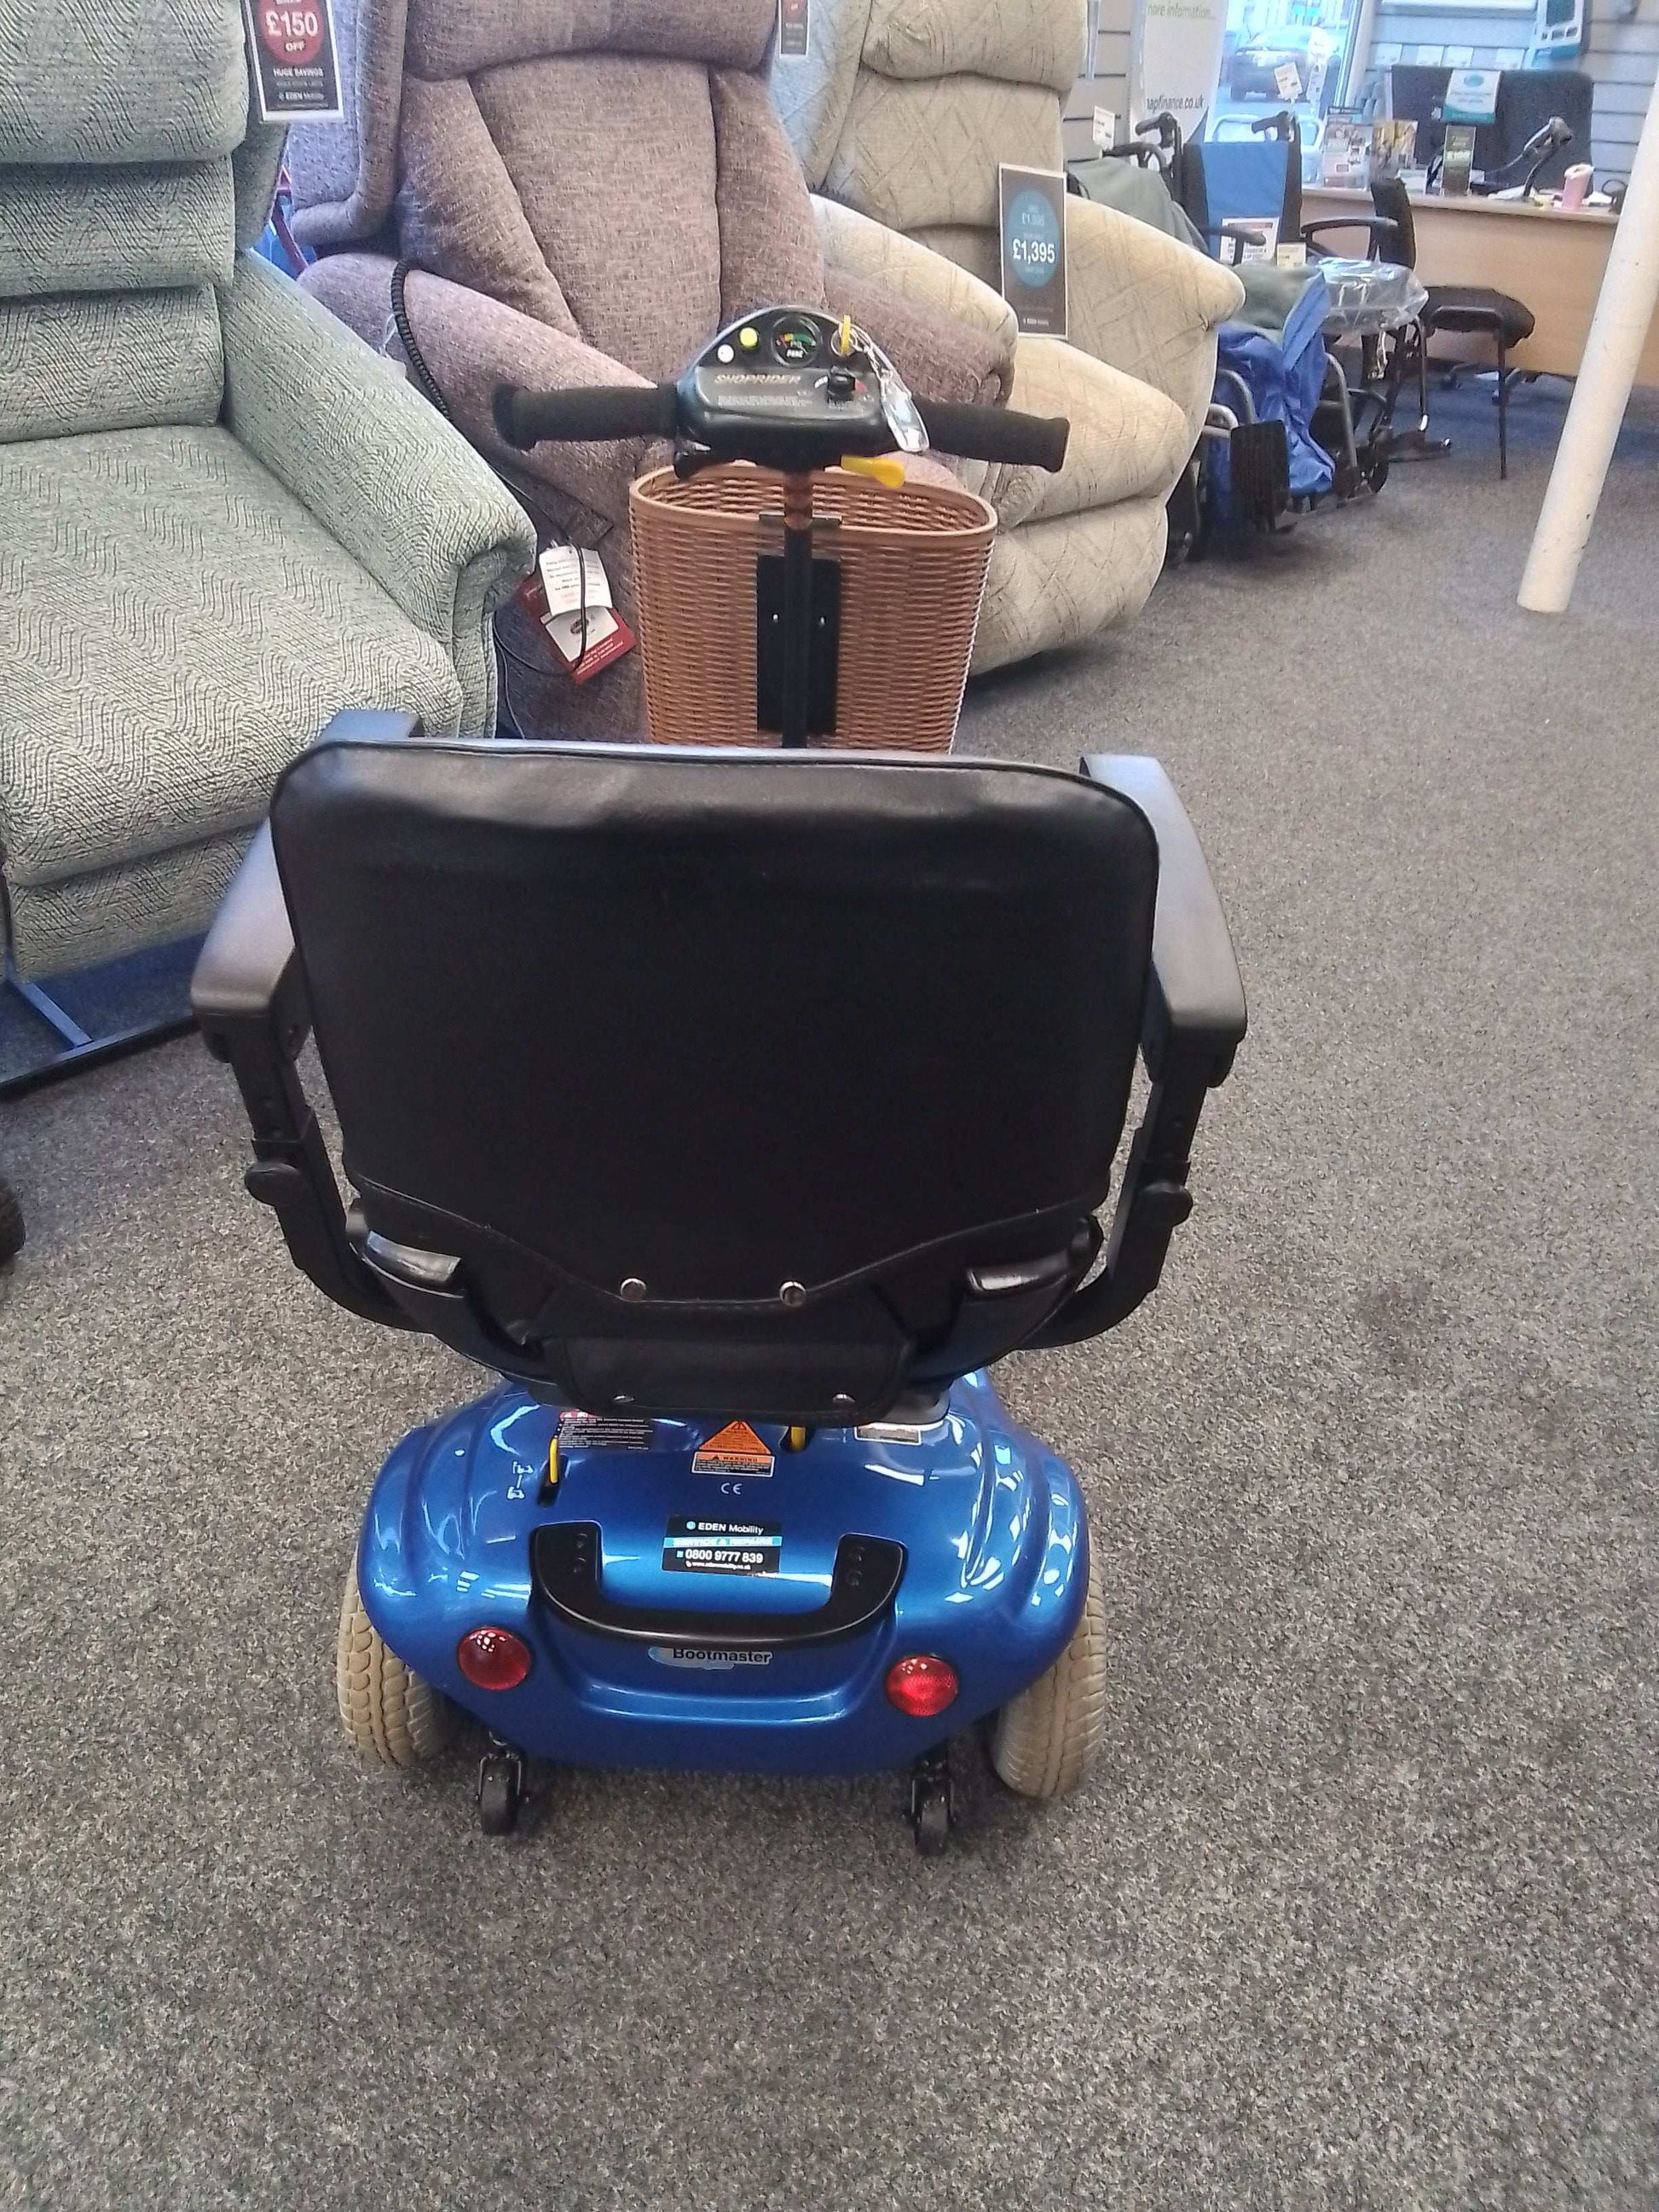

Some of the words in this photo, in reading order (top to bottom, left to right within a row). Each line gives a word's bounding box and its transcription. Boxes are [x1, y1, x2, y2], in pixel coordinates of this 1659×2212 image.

[265, 9, 319, 37] £150
[285, 40, 306, 52] OFF
[1012, 238, 1055, 264] £1,395
[697, 1522, 727, 1533] EDEN
[728, 1523, 765, 1536] Mobility
[685, 1549, 714, 1560] 0800
[714, 1551, 741, 1562] 9777
[742, 1551, 764, 1564] 839
[673, 1648, 772, 1663] Bootmaster
